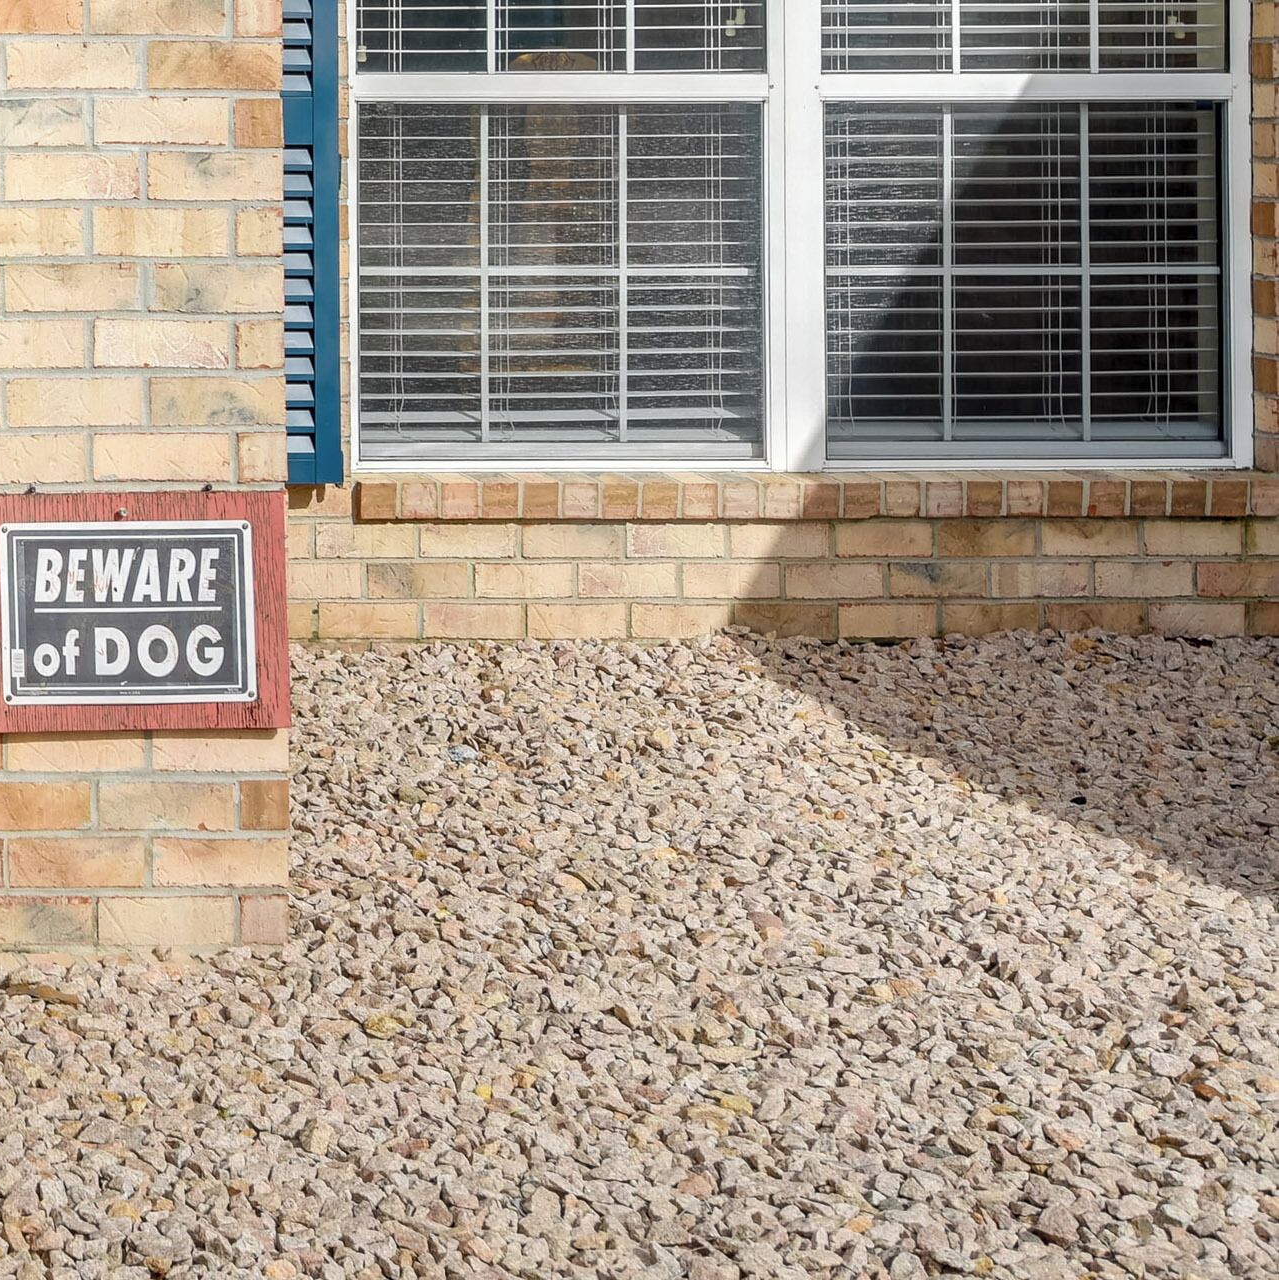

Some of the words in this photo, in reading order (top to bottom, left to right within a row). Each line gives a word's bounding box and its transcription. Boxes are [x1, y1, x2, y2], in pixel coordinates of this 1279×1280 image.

[34, 547, 220, 603] BEWARE
[32, 628, 80, 677] of
[93, 624, 225, 677] DOG
